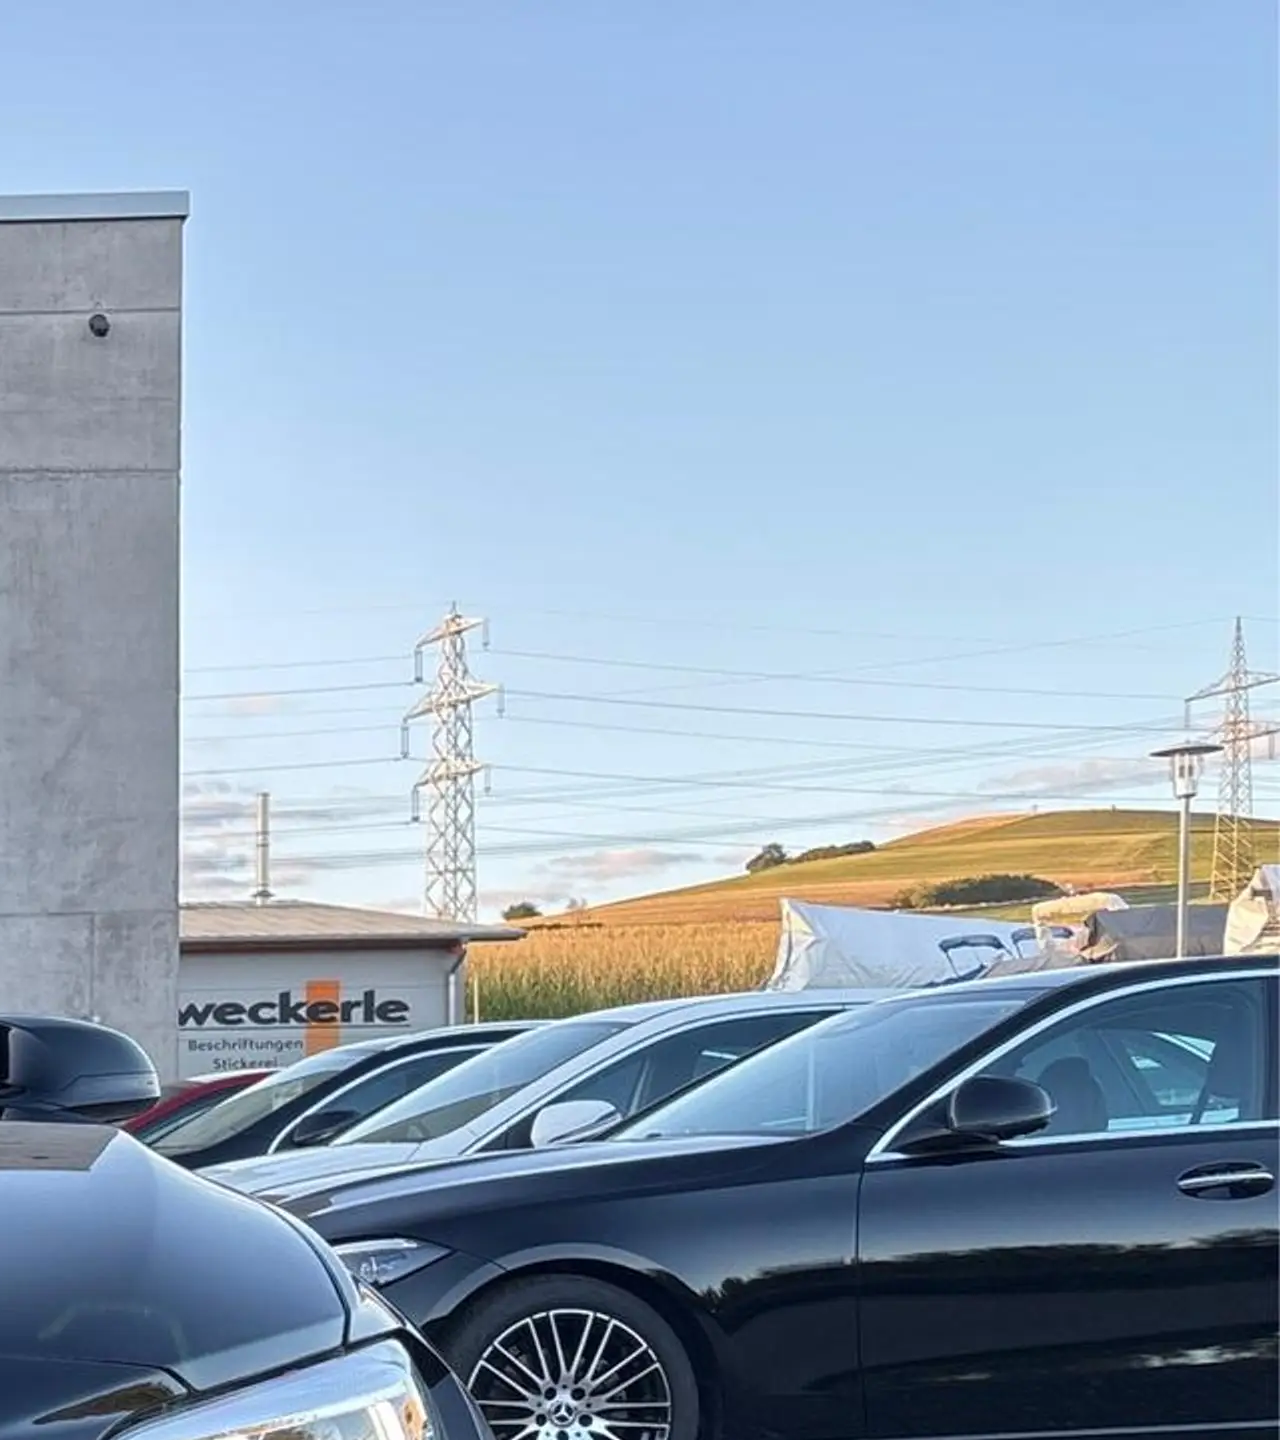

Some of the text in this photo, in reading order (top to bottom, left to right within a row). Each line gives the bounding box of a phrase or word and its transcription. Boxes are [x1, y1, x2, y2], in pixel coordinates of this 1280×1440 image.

[178, 989, 411, 1027] weckerle
[188, 1038, 304, 1052] Beschriftungen
[213, 1057, 279, 1070] Stickerei
